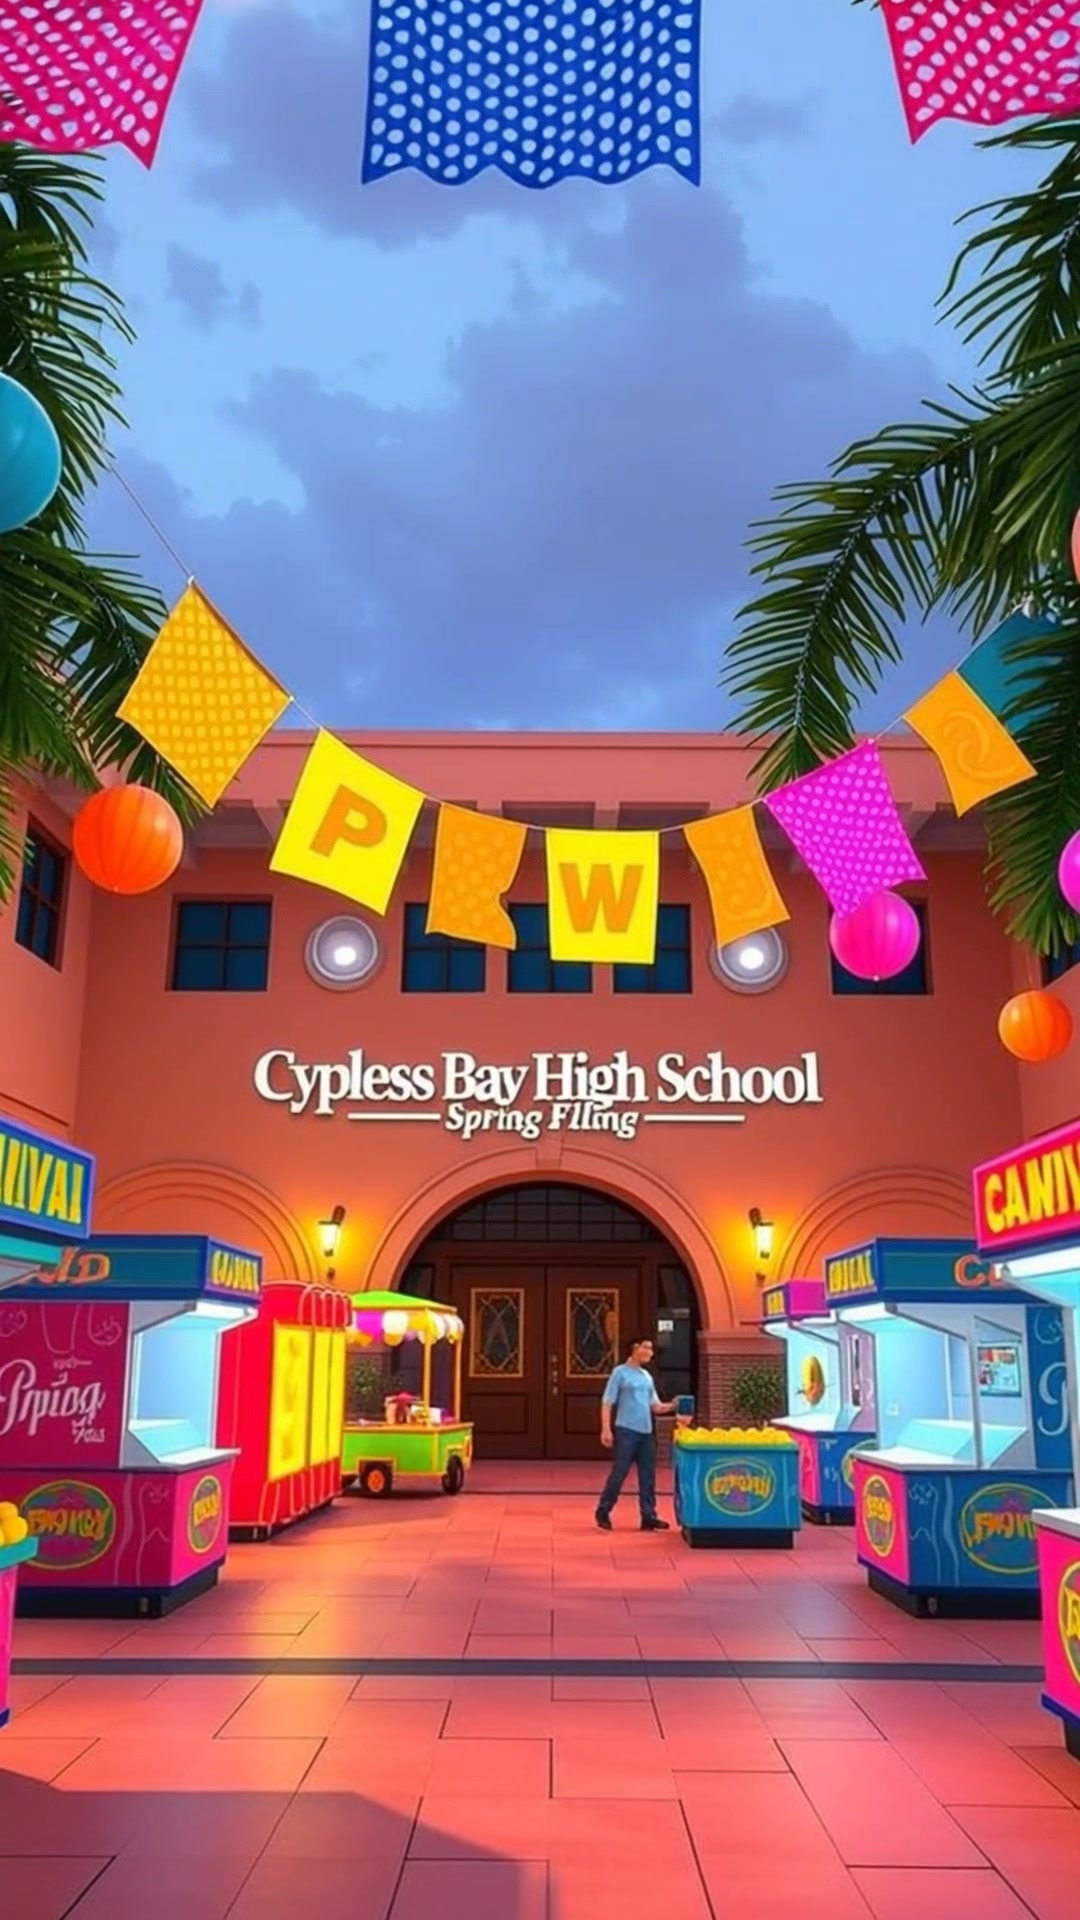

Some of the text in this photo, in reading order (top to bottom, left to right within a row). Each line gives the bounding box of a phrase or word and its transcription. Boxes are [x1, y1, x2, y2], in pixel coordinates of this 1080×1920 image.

[308, 783, 388, 858] P
[558, 862, 645, 934] W
[253, 1048, 824, 1115] Cypless Bay High School
